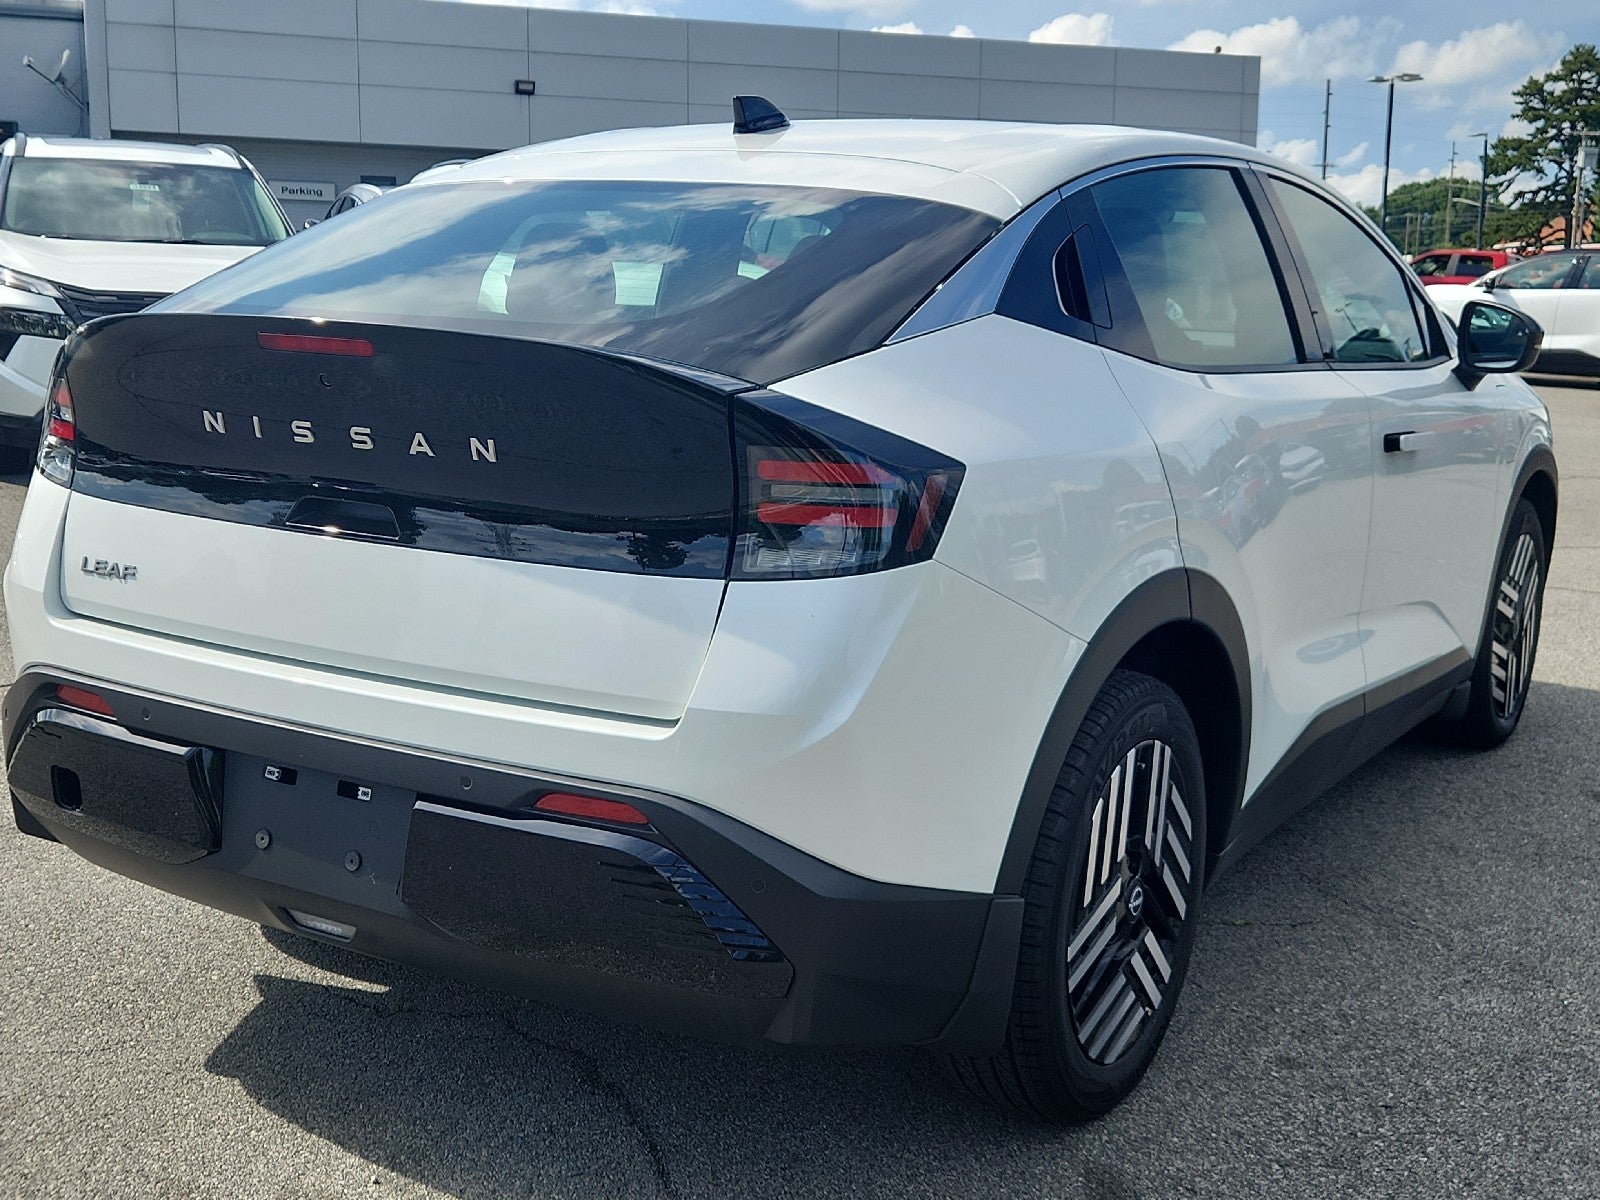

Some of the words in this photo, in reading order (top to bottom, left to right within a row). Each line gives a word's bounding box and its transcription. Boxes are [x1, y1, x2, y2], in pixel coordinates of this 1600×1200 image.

[281, 186, 323, 197] Parking
[202, 410, 497, 463] NISSAN
[80, 555, 138, 581] LEAF
